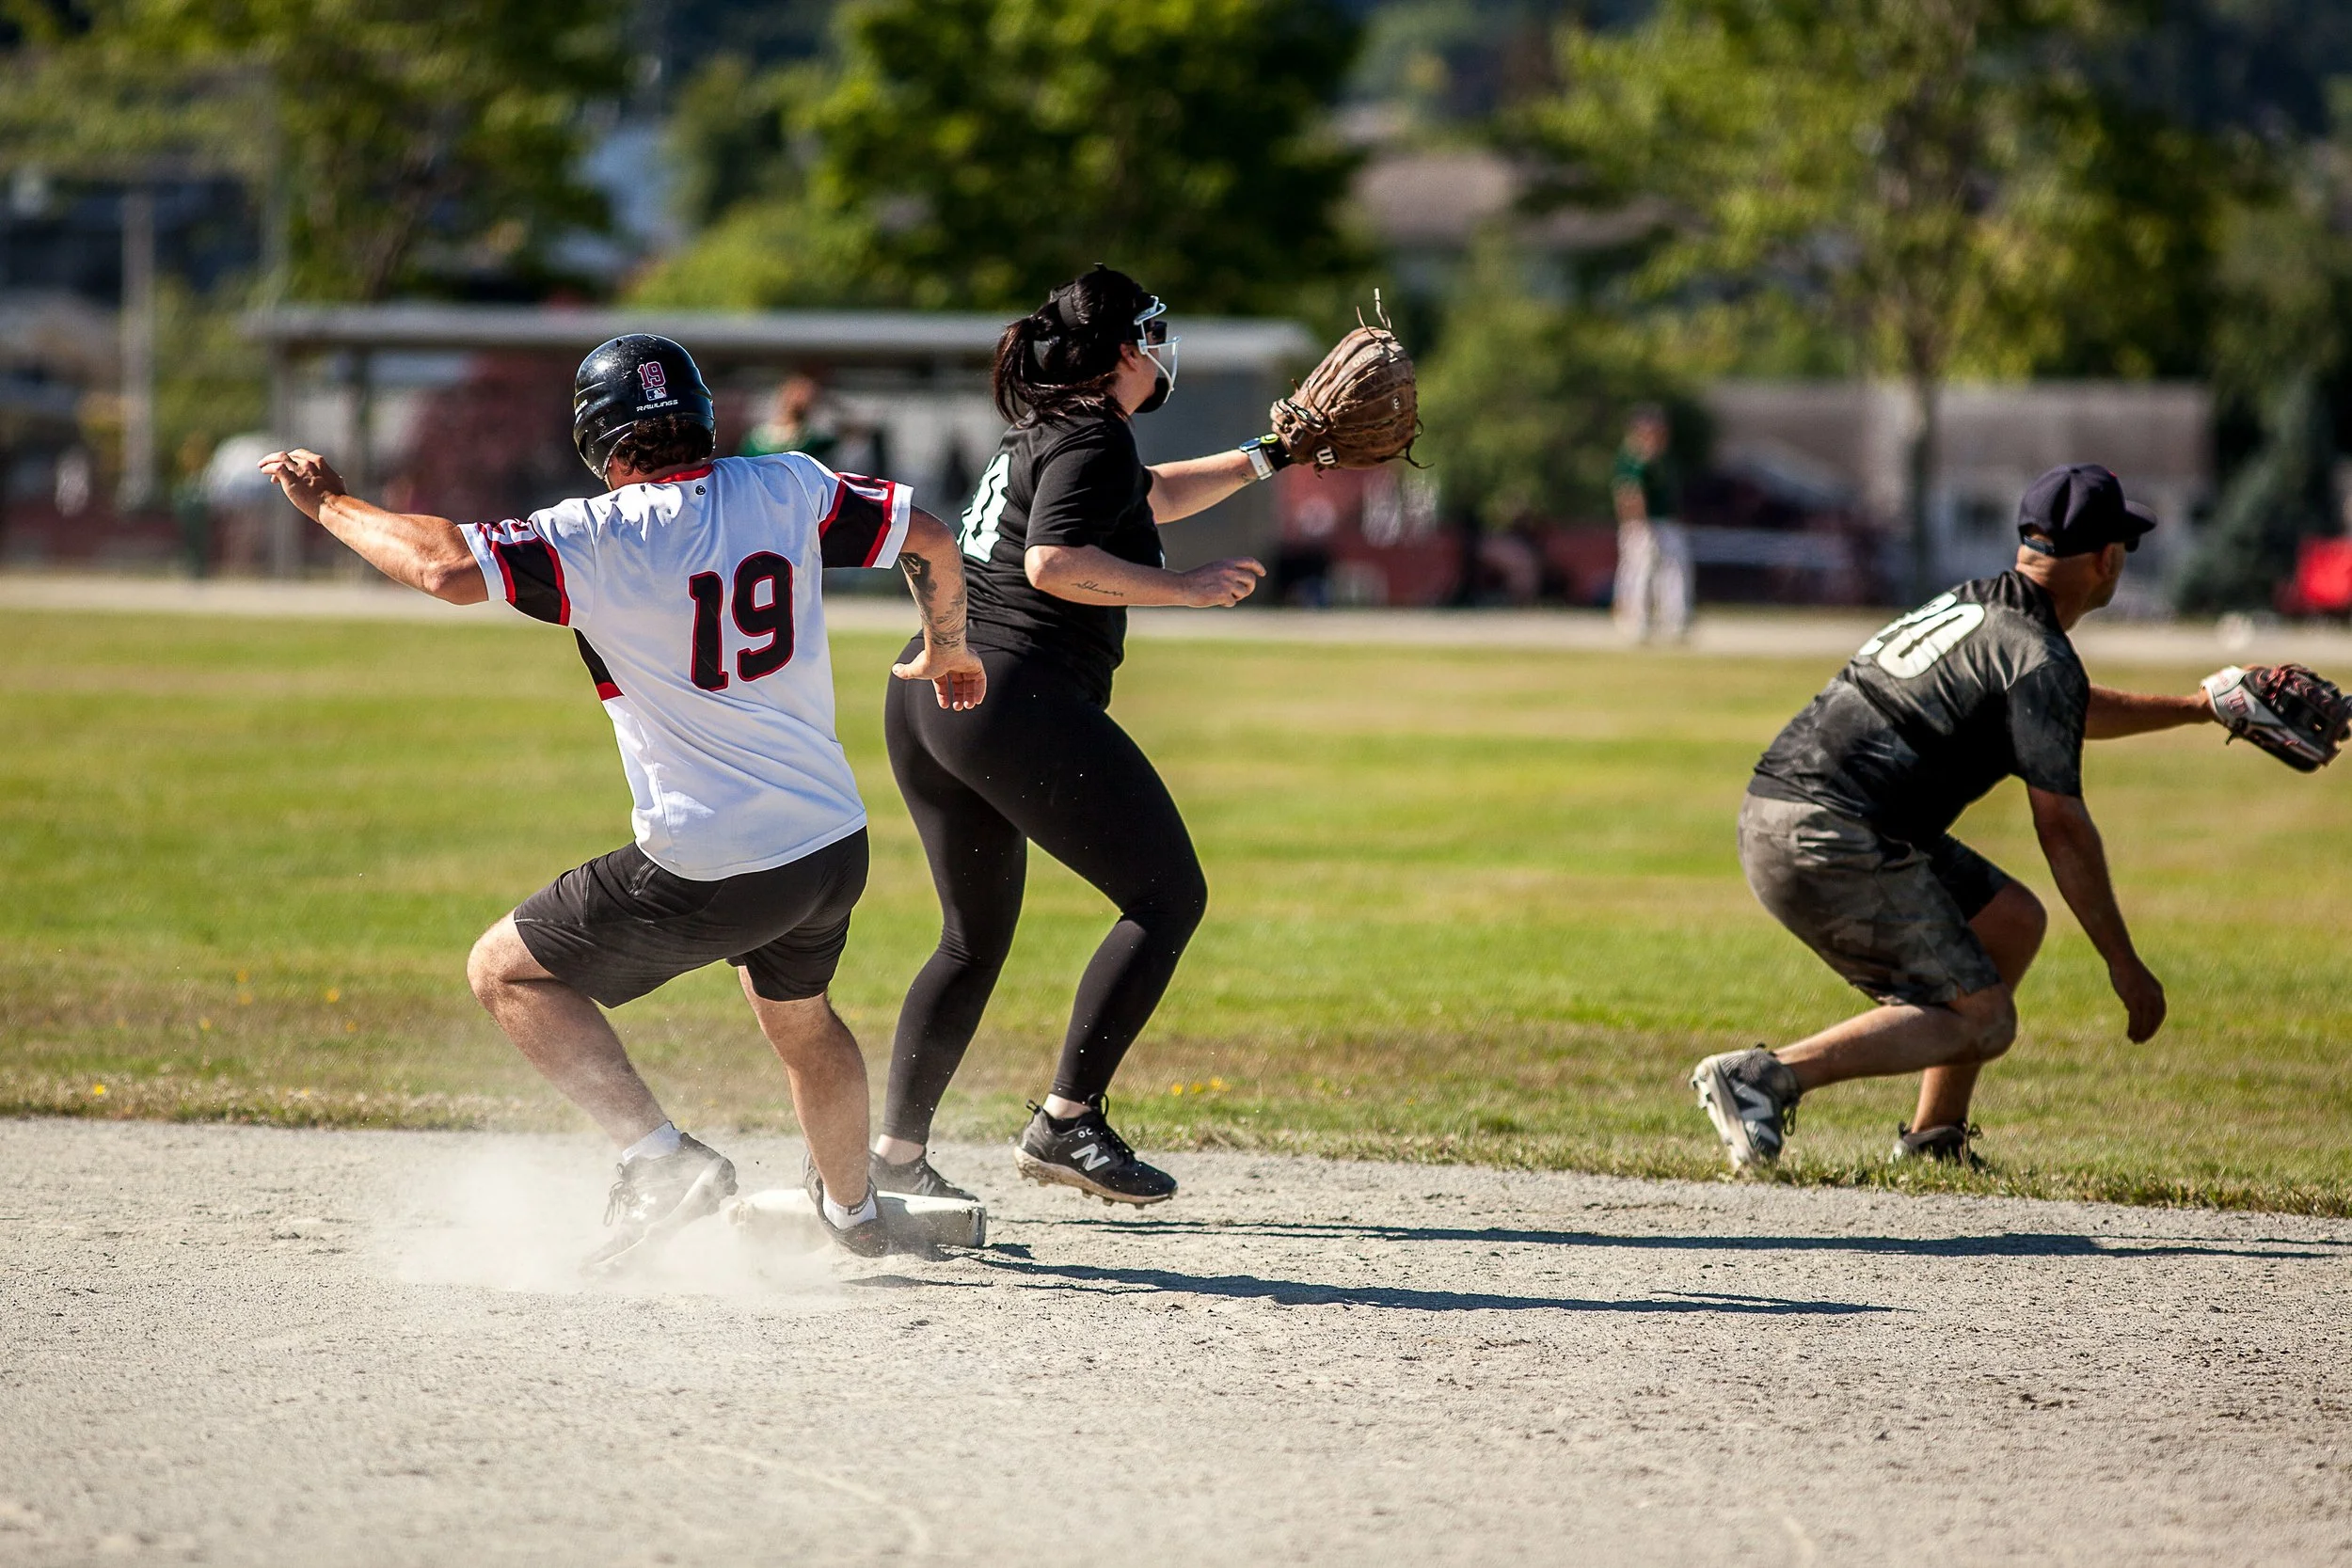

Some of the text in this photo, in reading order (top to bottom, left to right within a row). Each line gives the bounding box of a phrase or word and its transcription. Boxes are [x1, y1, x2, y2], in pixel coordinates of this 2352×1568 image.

[637, 361, 666, 389] 19
[636, 399, 678, 412] RAWLINGS
[956, 453, 1009, 563] 0
[688, 550, 795, 692] 19
[1070, 1142, 1110, 1171] N
